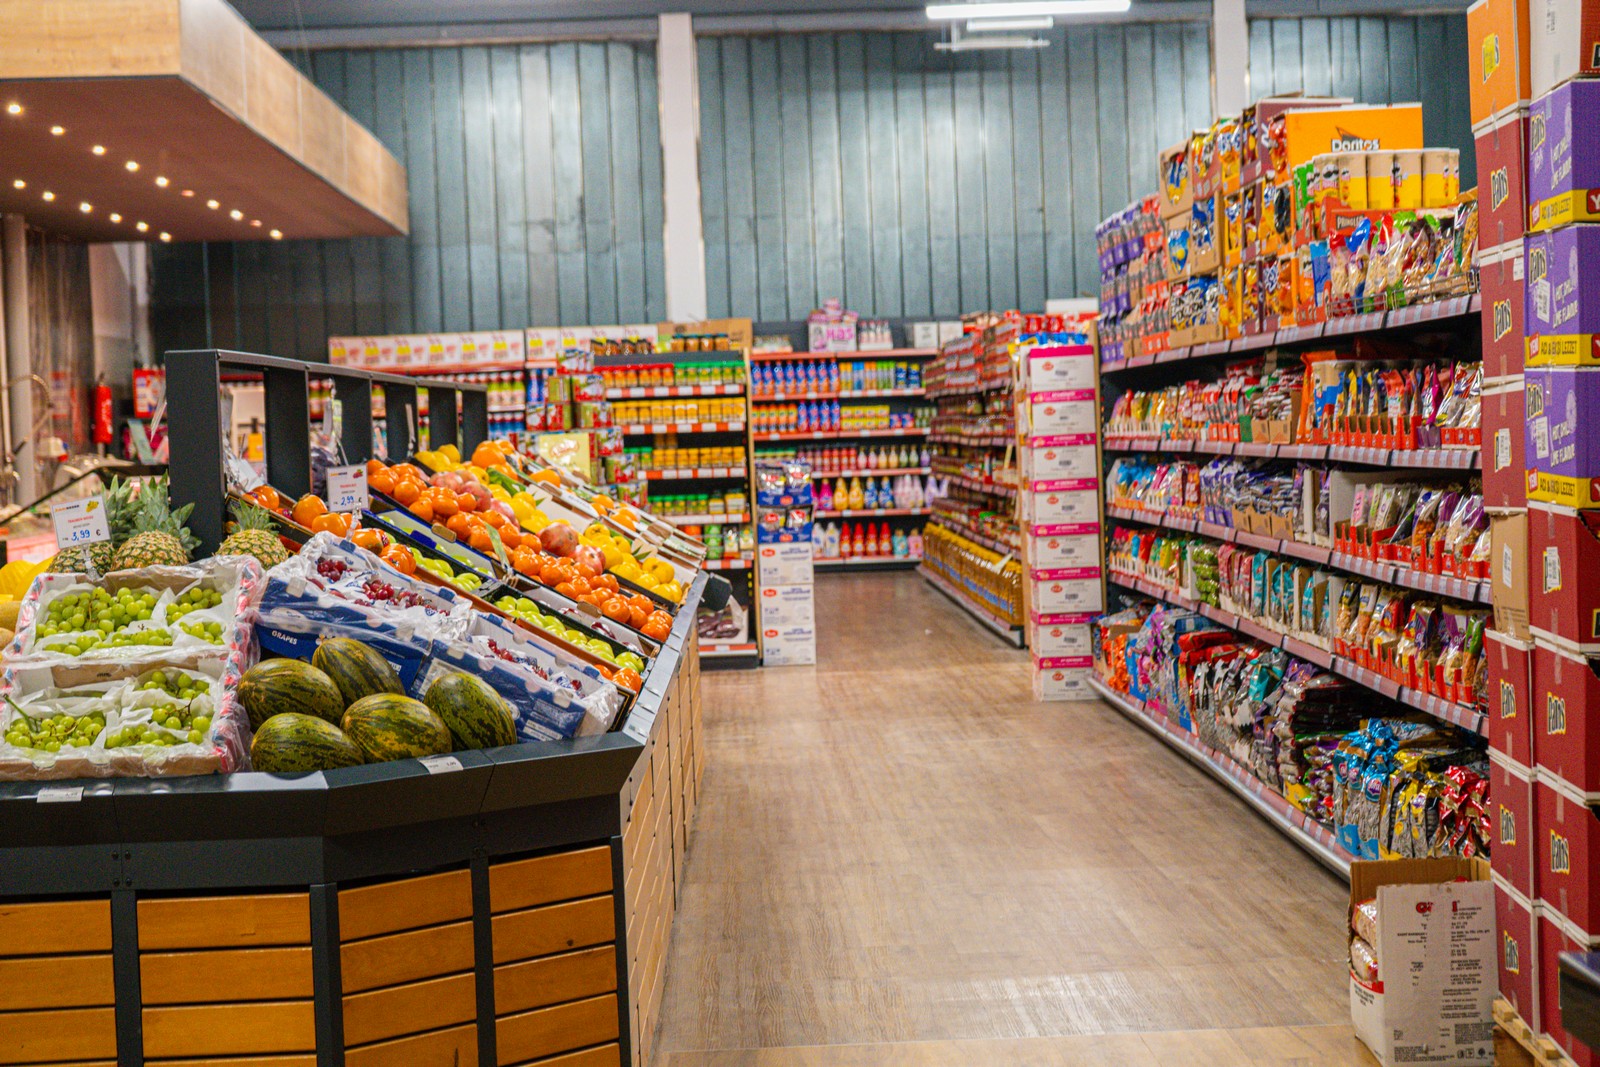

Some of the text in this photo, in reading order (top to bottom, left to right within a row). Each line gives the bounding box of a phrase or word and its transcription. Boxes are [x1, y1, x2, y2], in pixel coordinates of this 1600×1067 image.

[1331, 137, 1380, 152] Doritos
[71, 529, 91, 542] 3,99
[271, 629, 298, 646] GRAPES
